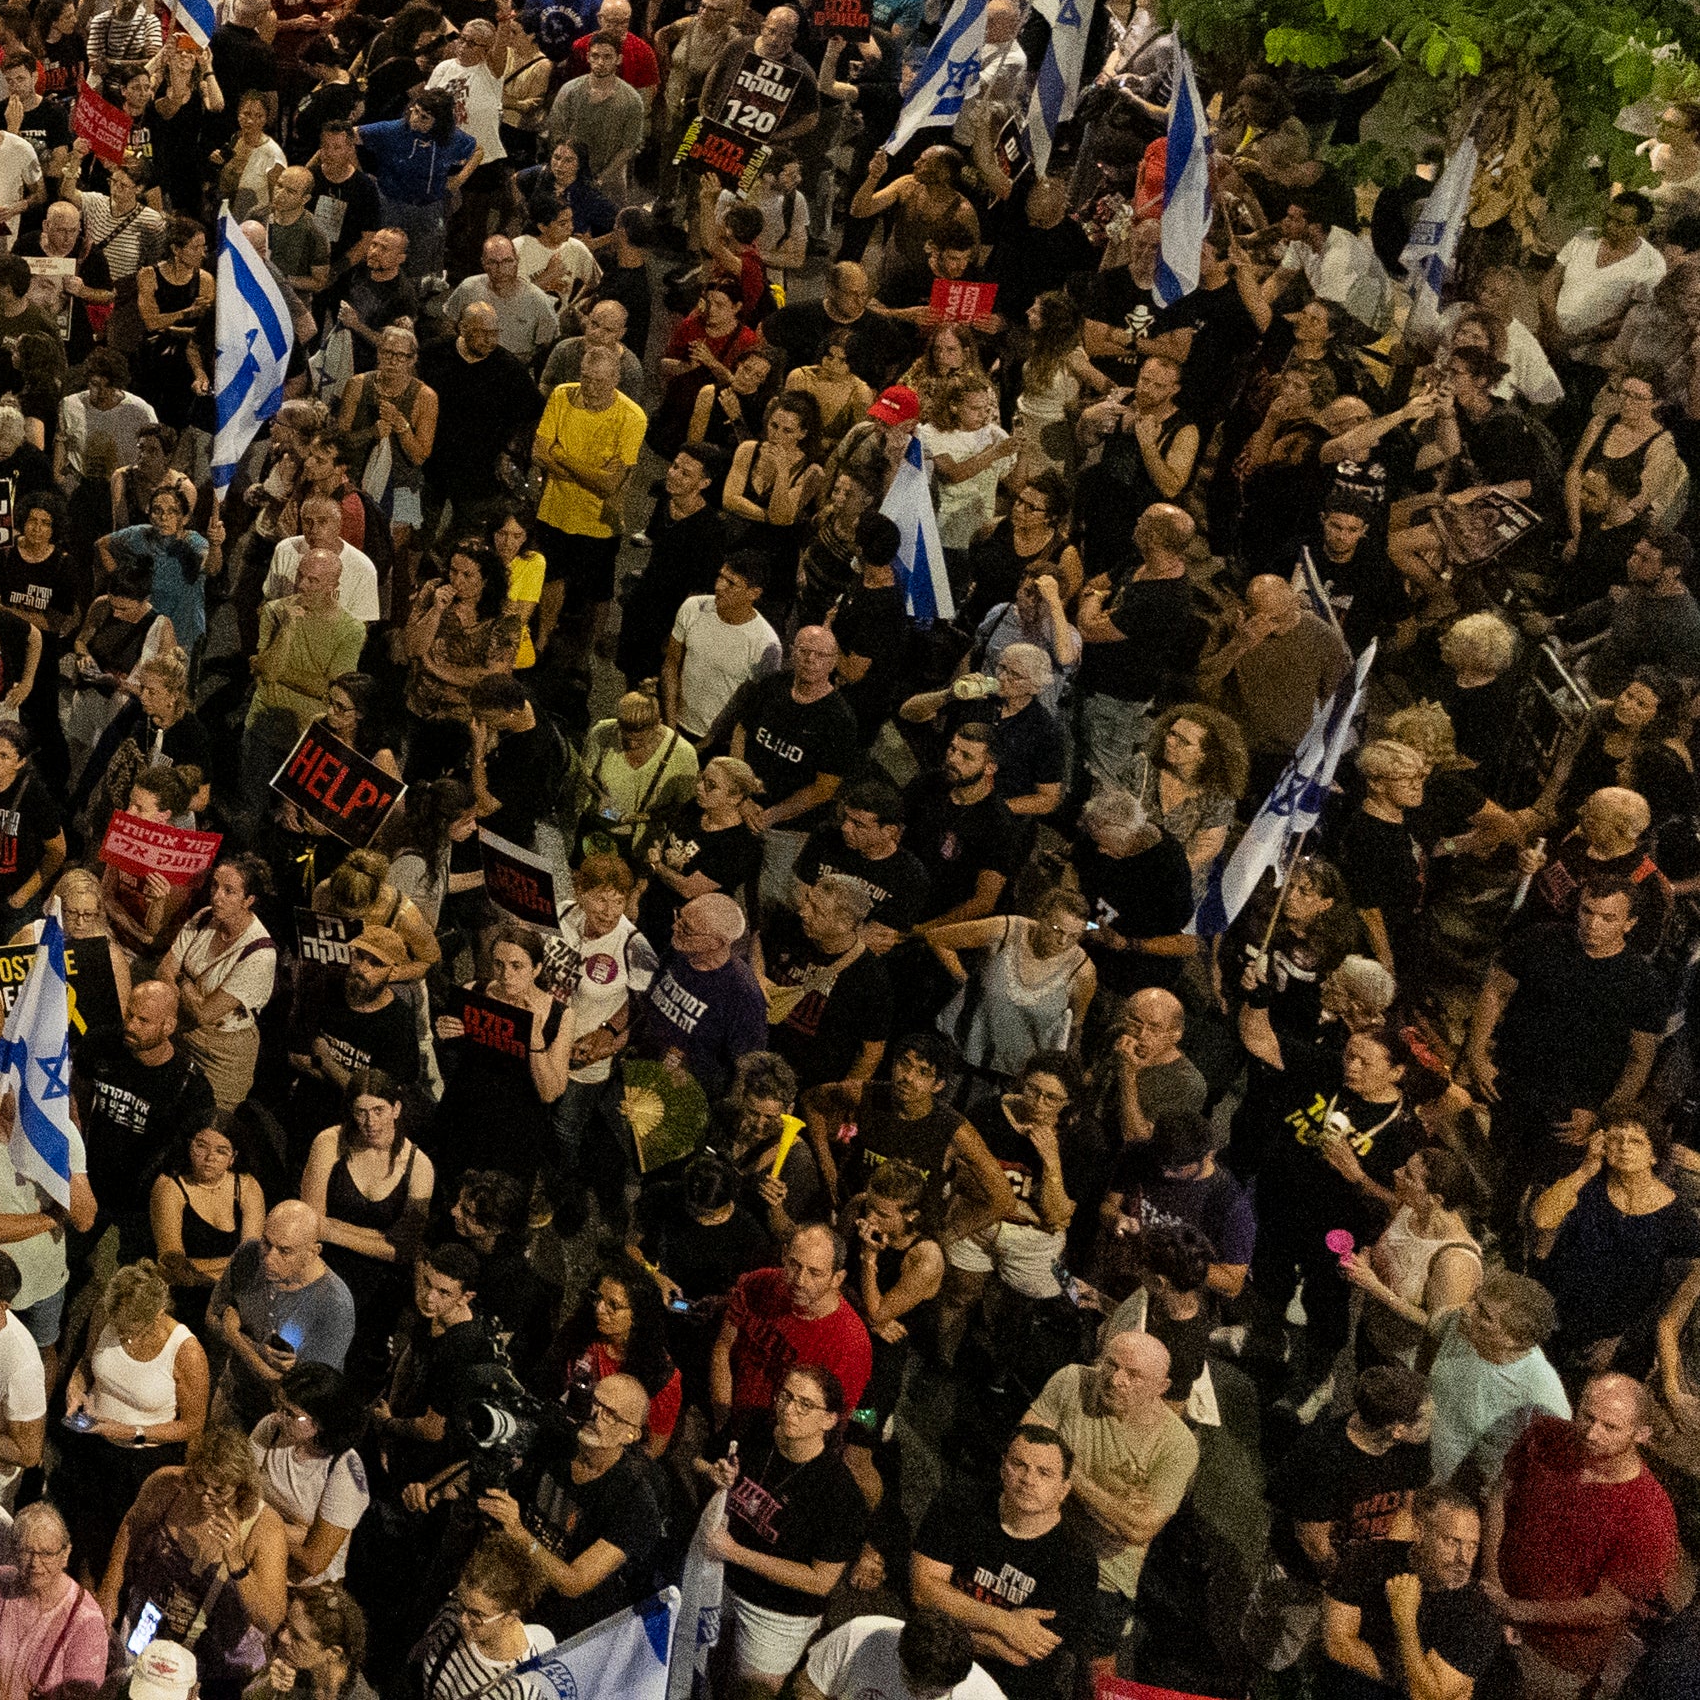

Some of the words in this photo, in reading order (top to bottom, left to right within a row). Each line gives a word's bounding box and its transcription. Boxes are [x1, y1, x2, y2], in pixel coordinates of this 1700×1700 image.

[759, 59, 785, 81] רק
[737, 70, 793, 102] עסקה
[725, 99, 777, 135] 120
[287, 739, 392, 819] HELP!
[183, 838, 216, 853] קול
[151, 852, 213, 874] זועק
[316, 913, 347, 941] רק
[302, 935, 352, 965] סקה
